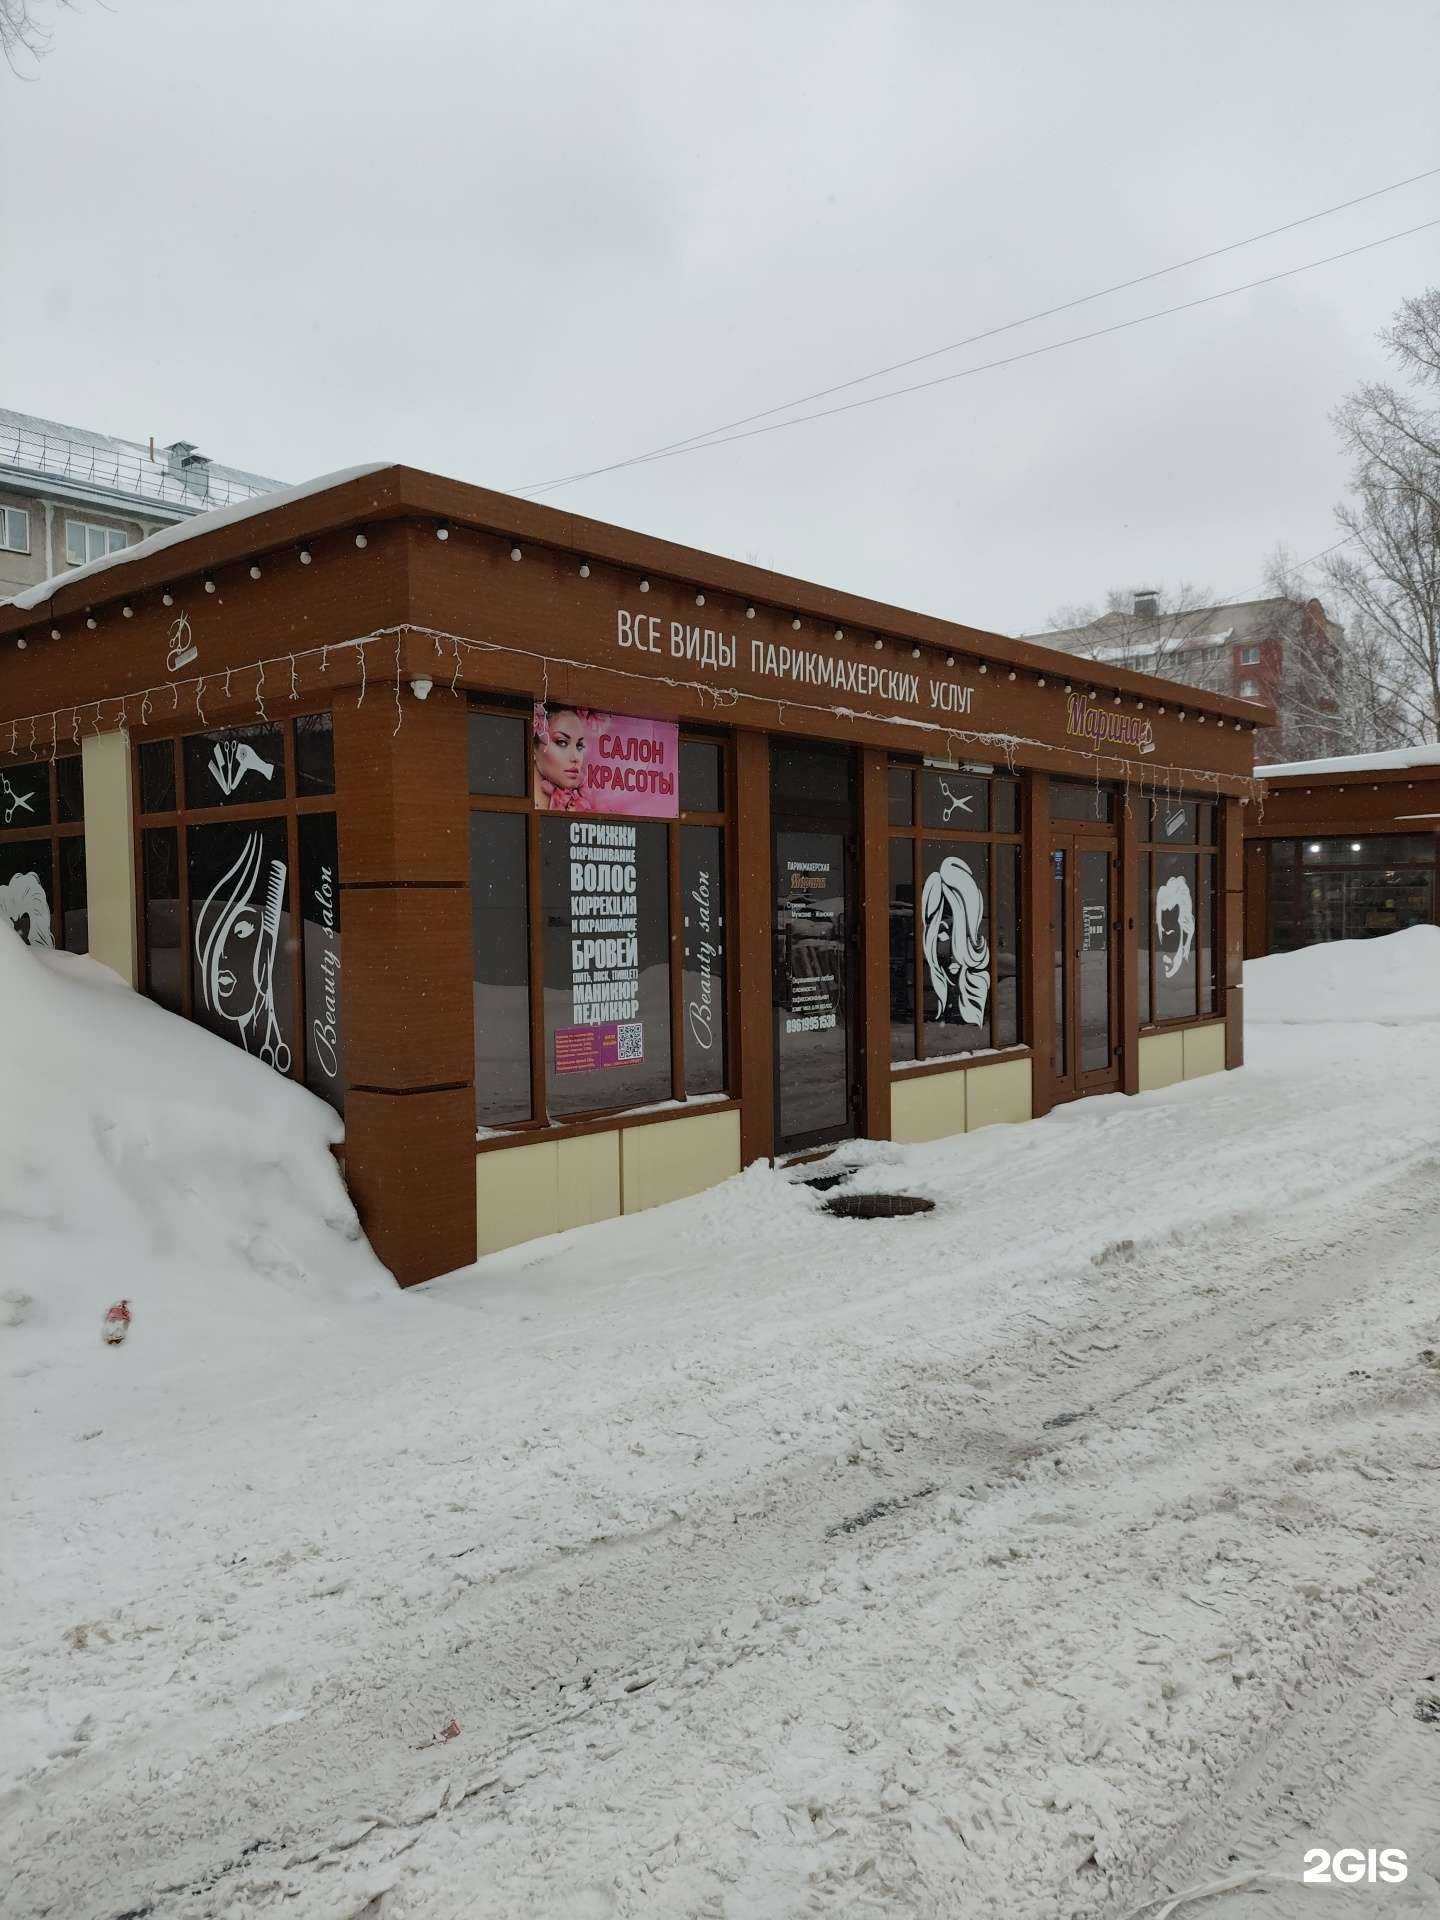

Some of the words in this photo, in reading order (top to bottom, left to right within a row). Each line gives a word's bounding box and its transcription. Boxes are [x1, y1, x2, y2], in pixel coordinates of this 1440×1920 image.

[617, 609, 662, 654] ВСЕ
[670, 622, 736, 671] ВИДЫ
[751, 640, 920, 704] ПАРИКМАХЕРСКИХ
[929, 680, 975, 714] УСЛУГ
[1066, 692, 1142, 751] Марина
[598, 733, 665, 764] САЛОН
[587, 763, 675, 795] КРАСОТЫ
[570, 822, 637, 847] СТРИЖКИ
[570, 846, 636, 863] ОКРАШИВАНИЕ
[570, 862, 638, 894] ВОЛОС
[314, 865, 334, 939] salon
[571, 895, 638, 917] КОРРЕКЦИЯ
[692, 870, 711, 933] salon
[571, 919, 578, 933] И
[579, 918, 638, 933] ОКРАШИВАНИЕ
[571, 933, 639, 970] БРОВЕЙ
[573, 980, 639, 1004] МАНИКЮР
[689, 940, 717, 1050] Beauty
[314, 948, 341, 1078] Beauty
[573, 1000, 640, 1027] ПЕДИКЮР
